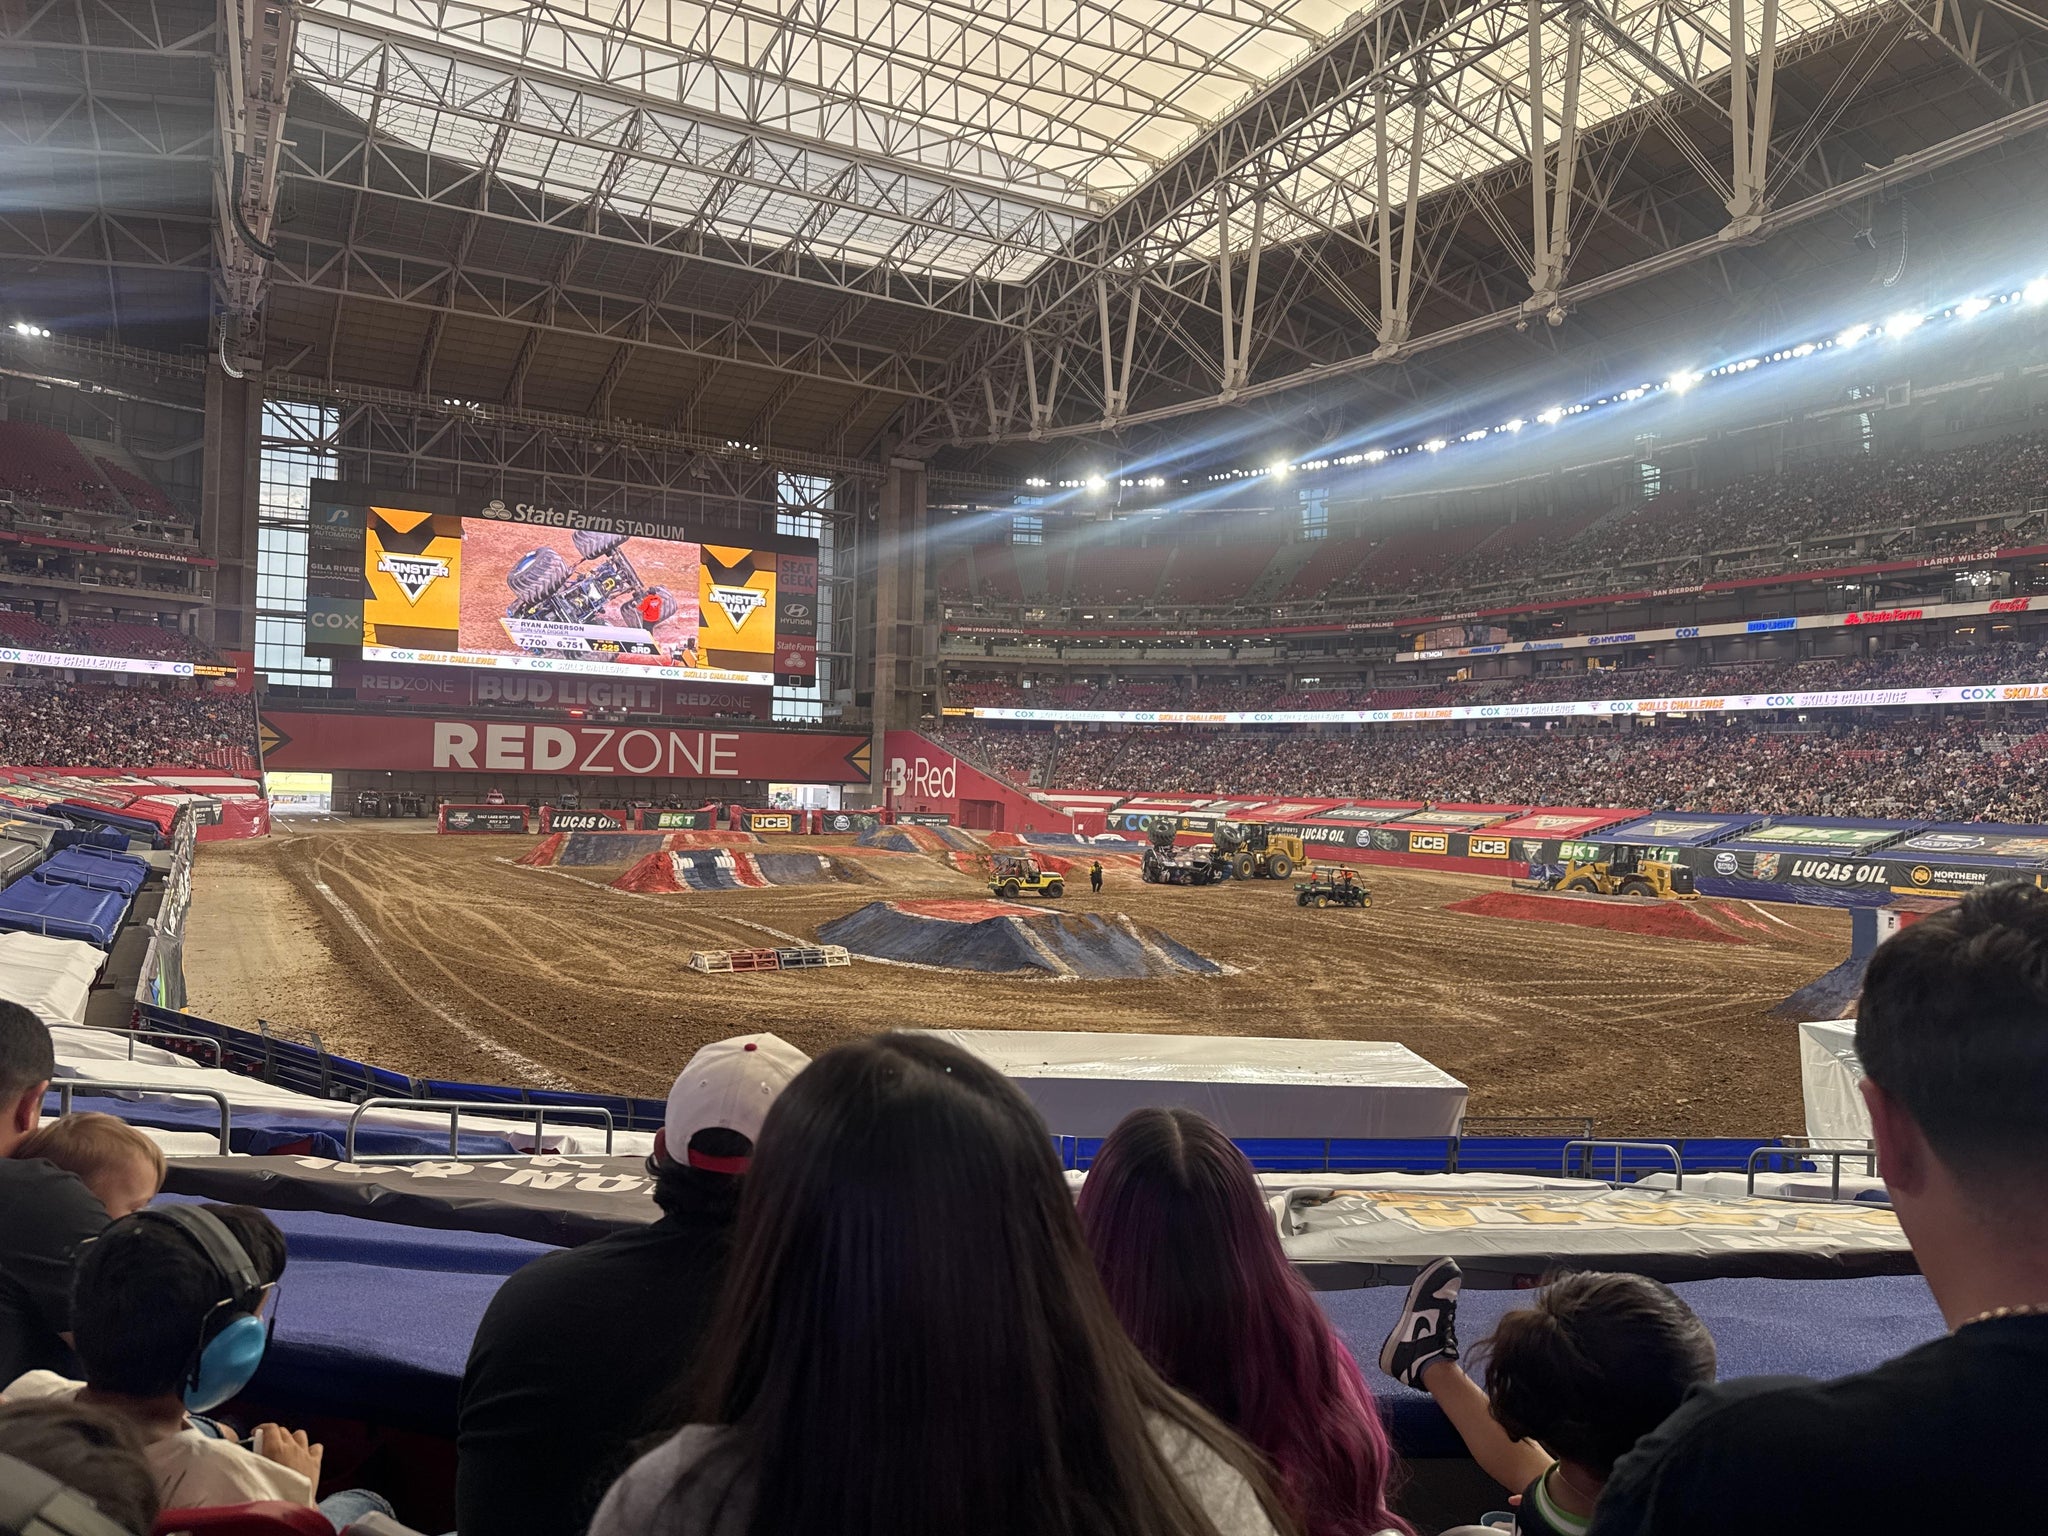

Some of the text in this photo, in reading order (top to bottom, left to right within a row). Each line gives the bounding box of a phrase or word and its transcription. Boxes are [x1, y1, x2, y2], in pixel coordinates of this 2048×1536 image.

[311, 524, 363, 534] PACIFIC OFFICE
[514, 503, 685, 541] State Farm STADIUM
[314, 530, 361, 540] AUTOMATION
[109, 547, 188, 562] JIMMY CONZELMAN
[1924, 556, 1955, 566] LARRY
[1958, 552, 1997, 562] WILSON
[311, 563, 360, 573] GILA RIVER
[378, 561, 449, 577] MONSTER
[781, 560, 813, 575] SEAT
[397, 574, 430, 585] JAM
[780, 574, 813, 588] GEEK
[709, 592, 766, 607] MONSTER
[725, 604, 752, 614] JAM
[1860, 609, 1923, 623] State Farm
[311, 612, 360, 630] COX
[543, 623, 585, 632] ANDERSON
[780, 618, 813, 626] HYUNDAI
[1769, 619, 1795, 630] LIGHT
[1601, 634, 1636, 644] HYUNDAI
[1676, 628, 1699, 638] COX
[519, 638, 651, 654] 7.700 6.751 7.225 3RD
[0, 649, 20, 660] OX
[63, 657, 128, 670] CHALLENGE
[391, 651, 497, 665] COX SKILLS CHALLENGE
[531, 660, 552, 668] COX
[660, 668, 749, 682] COX SKILLS CHALLENGE
[478, 676, 553, 702] BUD
[1961, 685, 2048, 700] COX SKILLS
[1610, 699, 1725, 712] COX SKILLS CHALLENGE
[1766, 691, 1907, 706] COX SKILLS CHALLENGE
[1392, 711, 1413, 719] SKILLS
[1415, 709, 1452, 719] CHALLENGE
[1481, 707, 1500, 716] COX
[433, 722, 739, 775] REDZONE
[914, 757, 957, 798] Red
[552, 816, 596, 828] LUCAS
[659, 815, 695, 826] BKT
[755, 817, 789, 828] JCB
[1300, 828, 1345, 842] LUCAS OIL
[1413, 837, 1445, 849] JCB
[1471, 840, 1507, 855] JCB
[1561, 843, 1600, 858] BKT
[1791, 860, 1853, 881] LUCAS
[1934, 870, 1986, 881] NORTHERN
